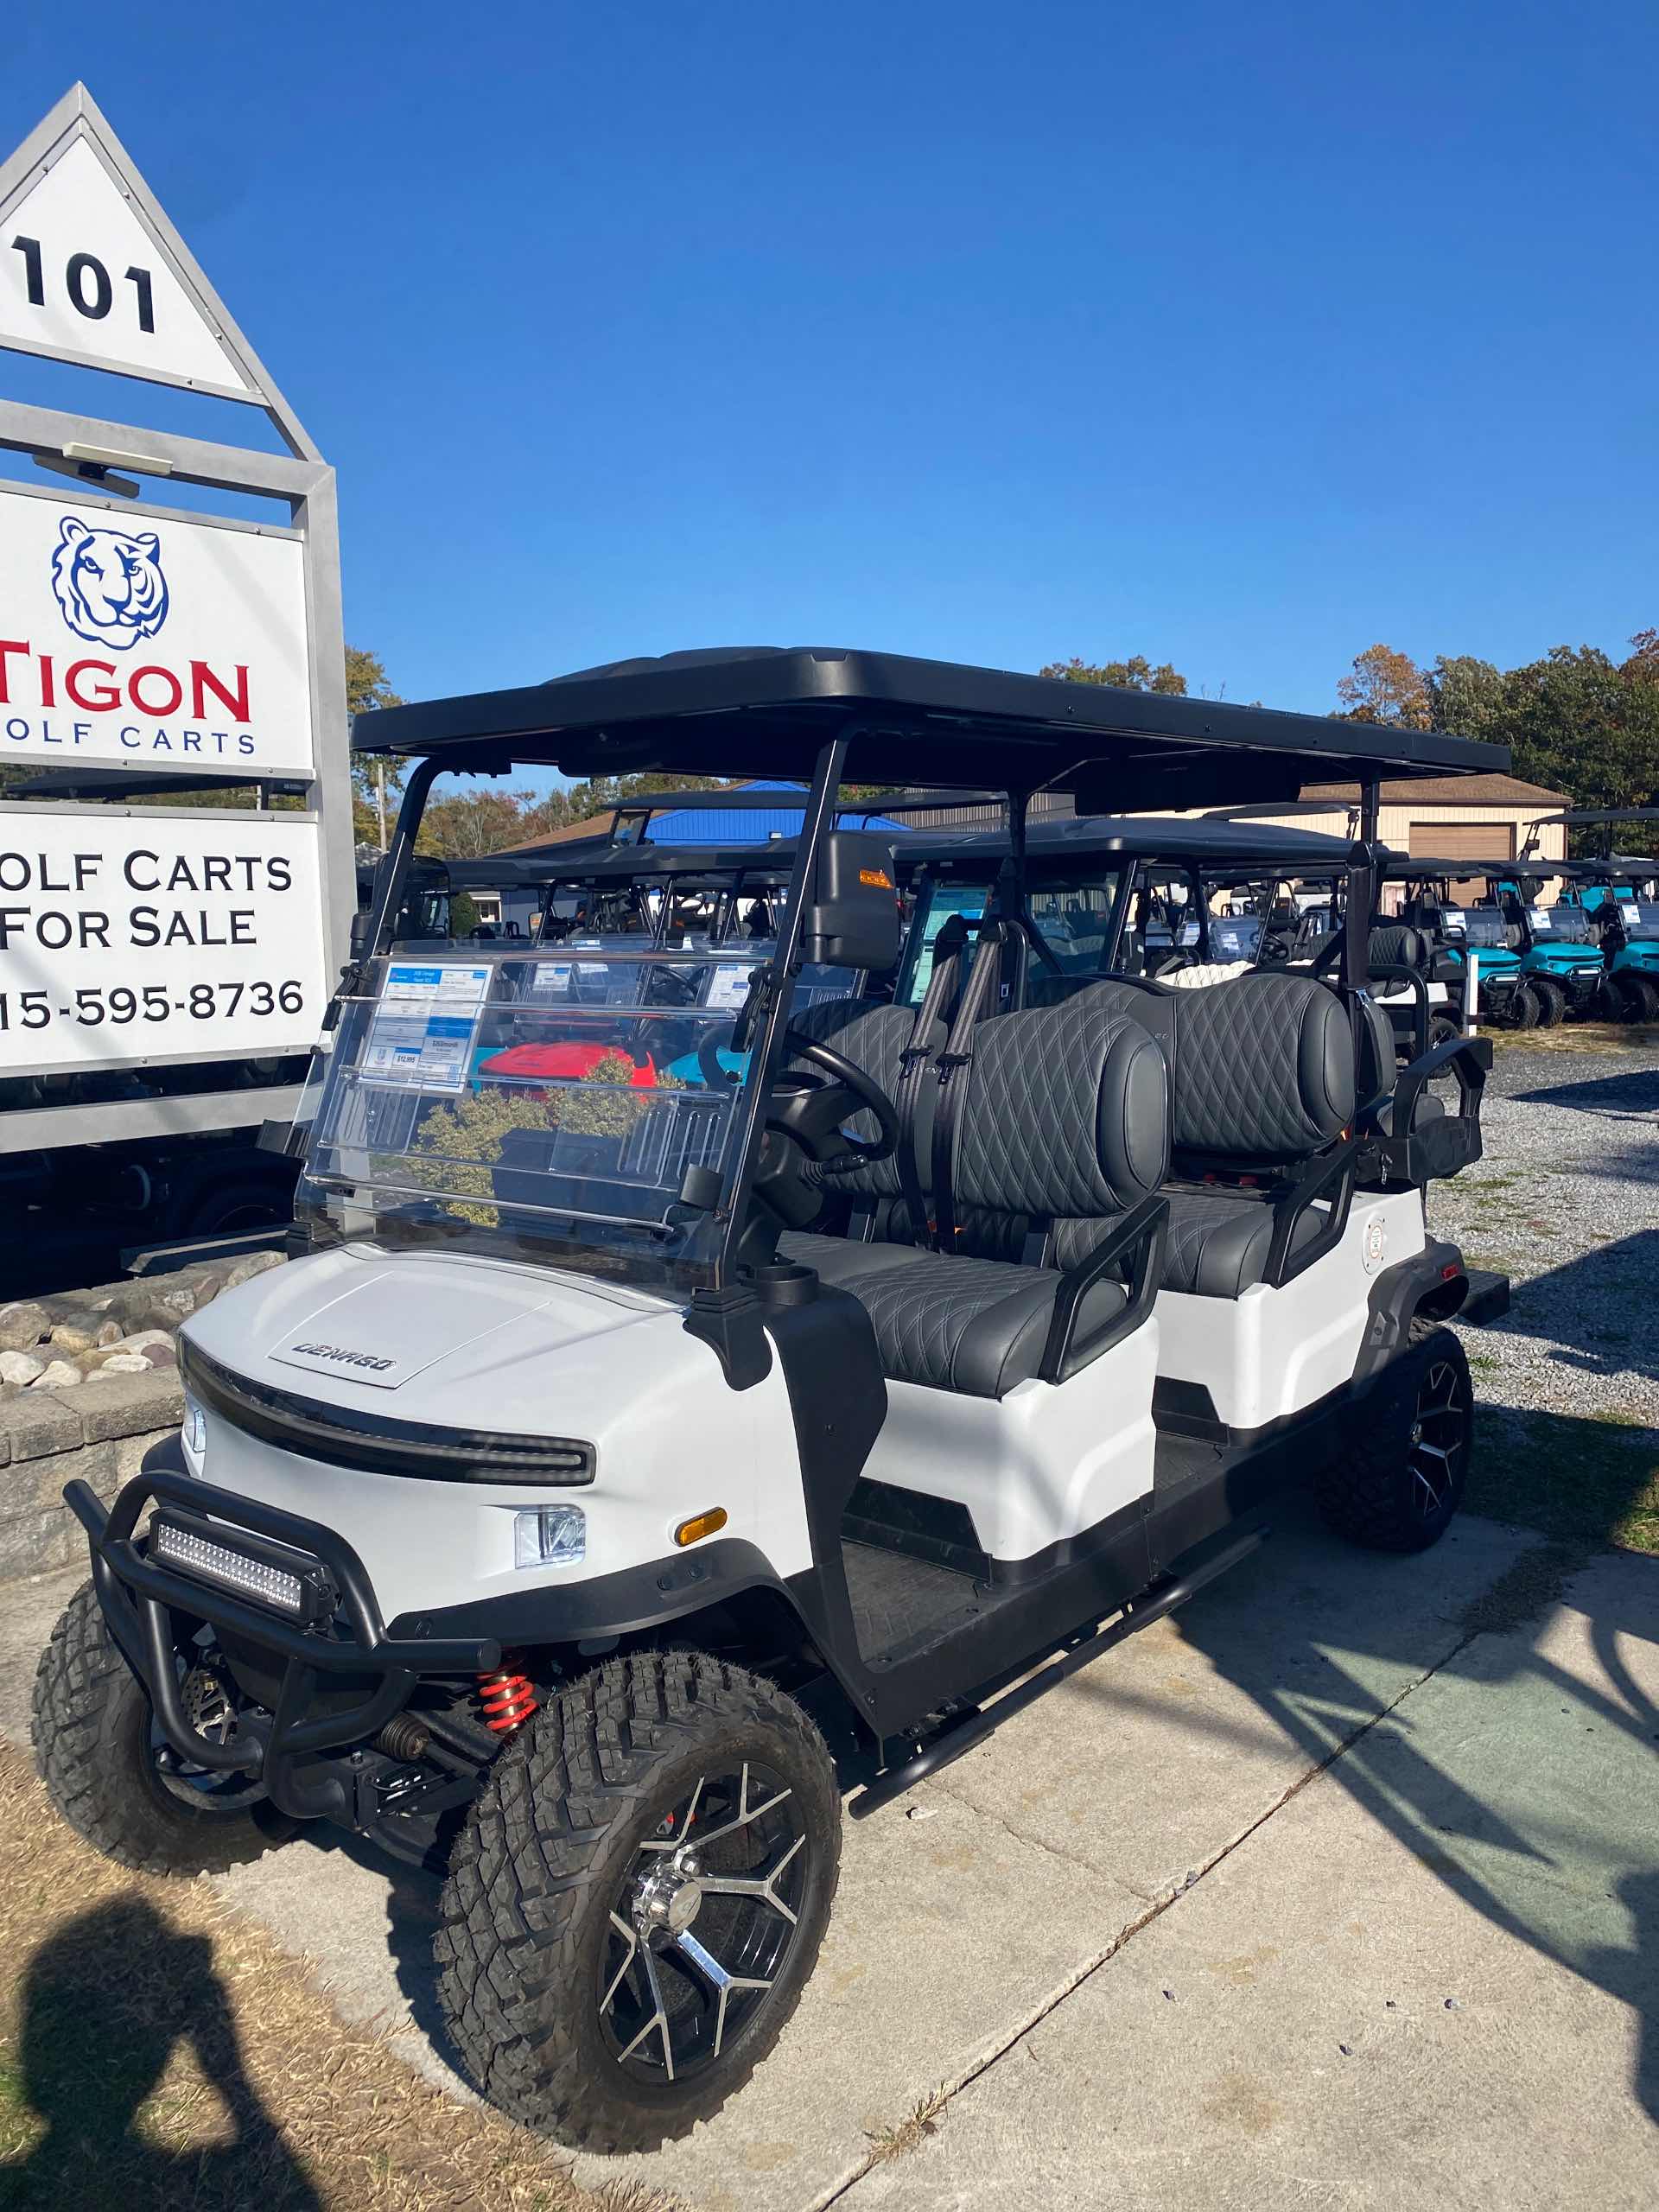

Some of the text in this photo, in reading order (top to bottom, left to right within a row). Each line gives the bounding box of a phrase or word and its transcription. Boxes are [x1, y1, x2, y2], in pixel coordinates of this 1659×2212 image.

[10, 235, 156, 334] 101
[0, 639, 251, 723] TIGON
[6, 718, 255, 755] OLF CARTS
[0, 849, 293, 892] OLF CARTS
[0, 906, 257, 950] FOR SALE
[0, 980, 303, 1031] 15-595-8736
